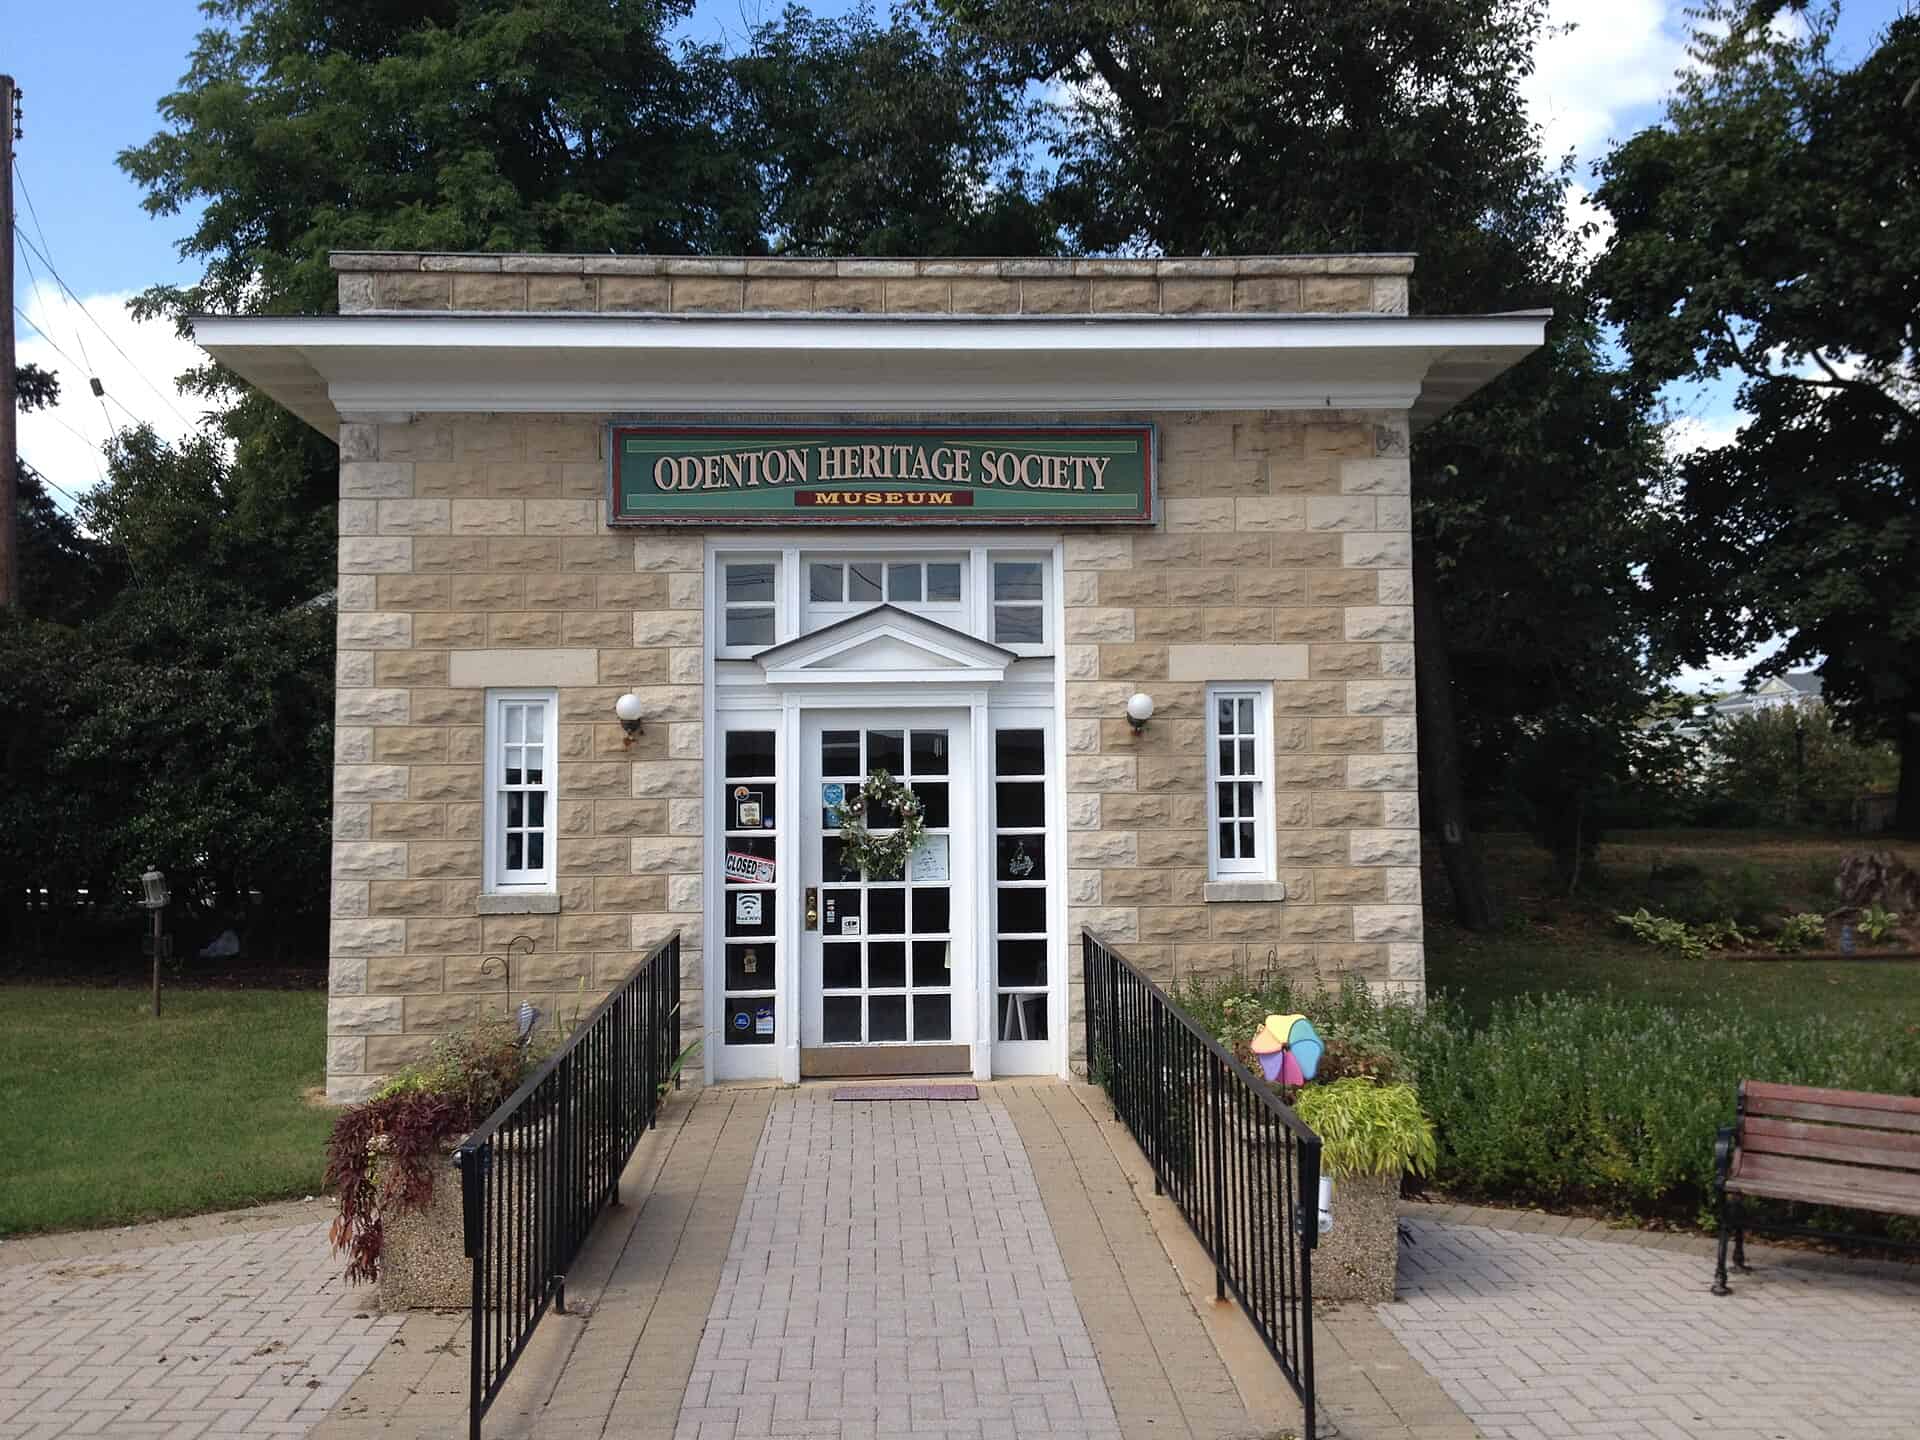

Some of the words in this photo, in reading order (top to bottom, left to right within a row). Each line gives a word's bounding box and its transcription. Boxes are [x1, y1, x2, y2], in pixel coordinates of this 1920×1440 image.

[653, 448, 809, 491] ODENTON
[818, 445, 972, 482] HERITAGE
[981, 450, 1109, 490] SOCIETY
[815, 491, 954, 505] MUSEUM
[726, 855, 758, 876] CLOSED
